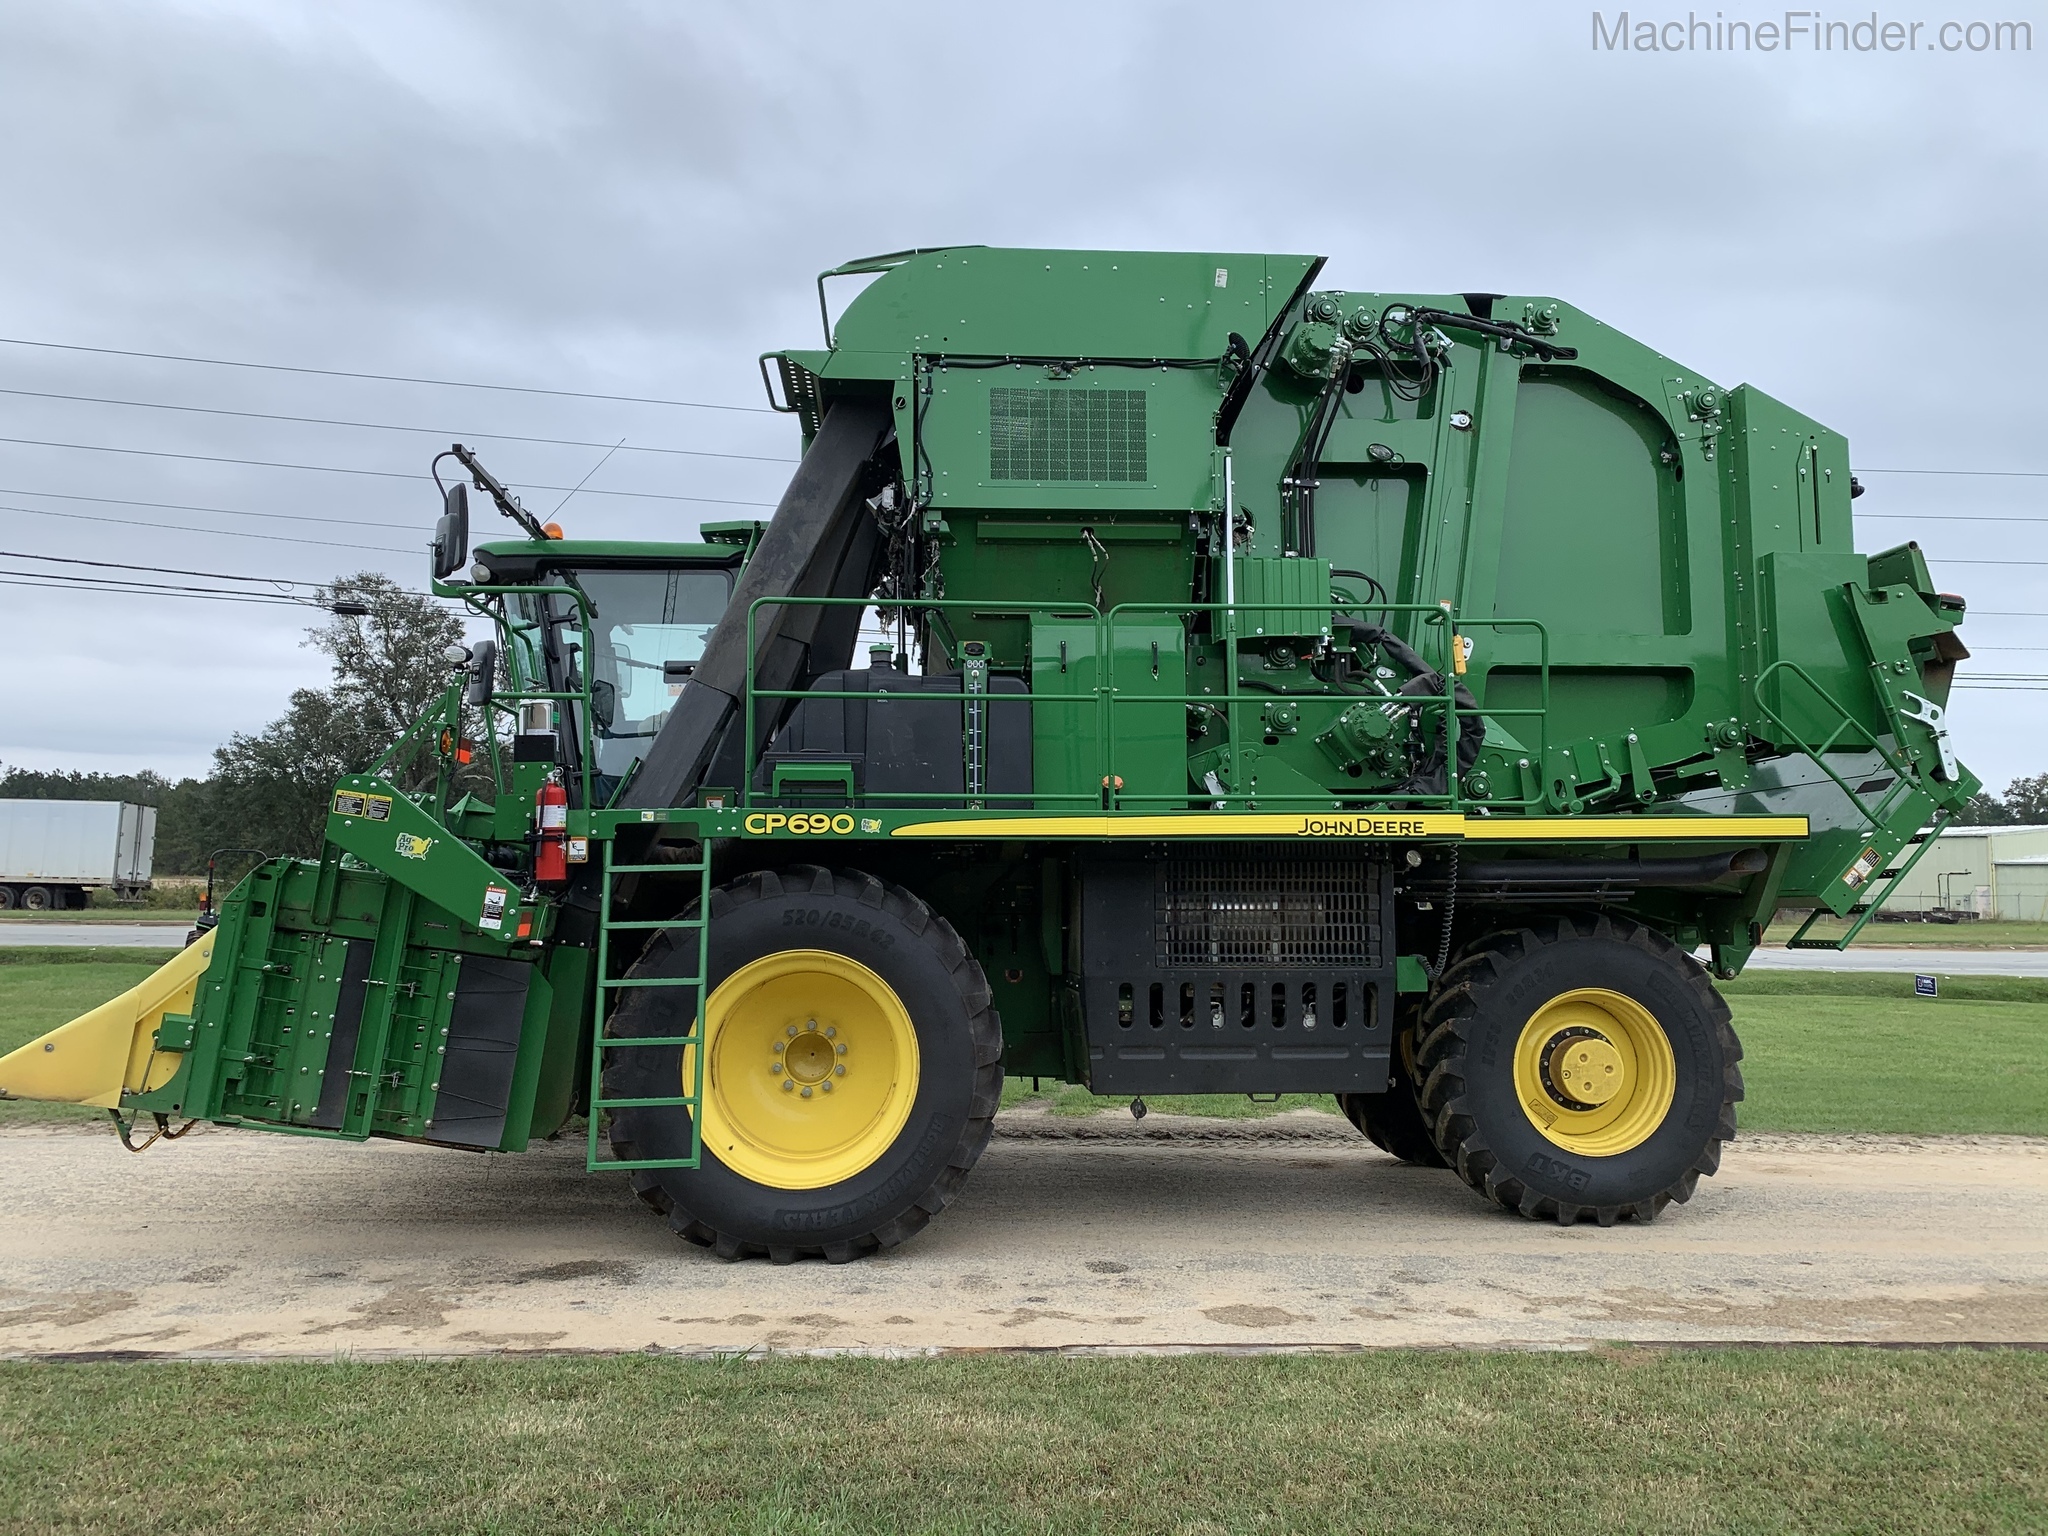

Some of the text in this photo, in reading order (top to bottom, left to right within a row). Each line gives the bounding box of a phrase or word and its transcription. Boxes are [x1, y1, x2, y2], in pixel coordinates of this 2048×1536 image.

[744, 813, 855, 835] CP690
[1298, 818, 1425, 834] JOHN DEERE
[397, 842, 414, 852] Pro
[781, 908, 896, 950] 520/85R42
[1527, 1156, 1590, 1191] BKT
